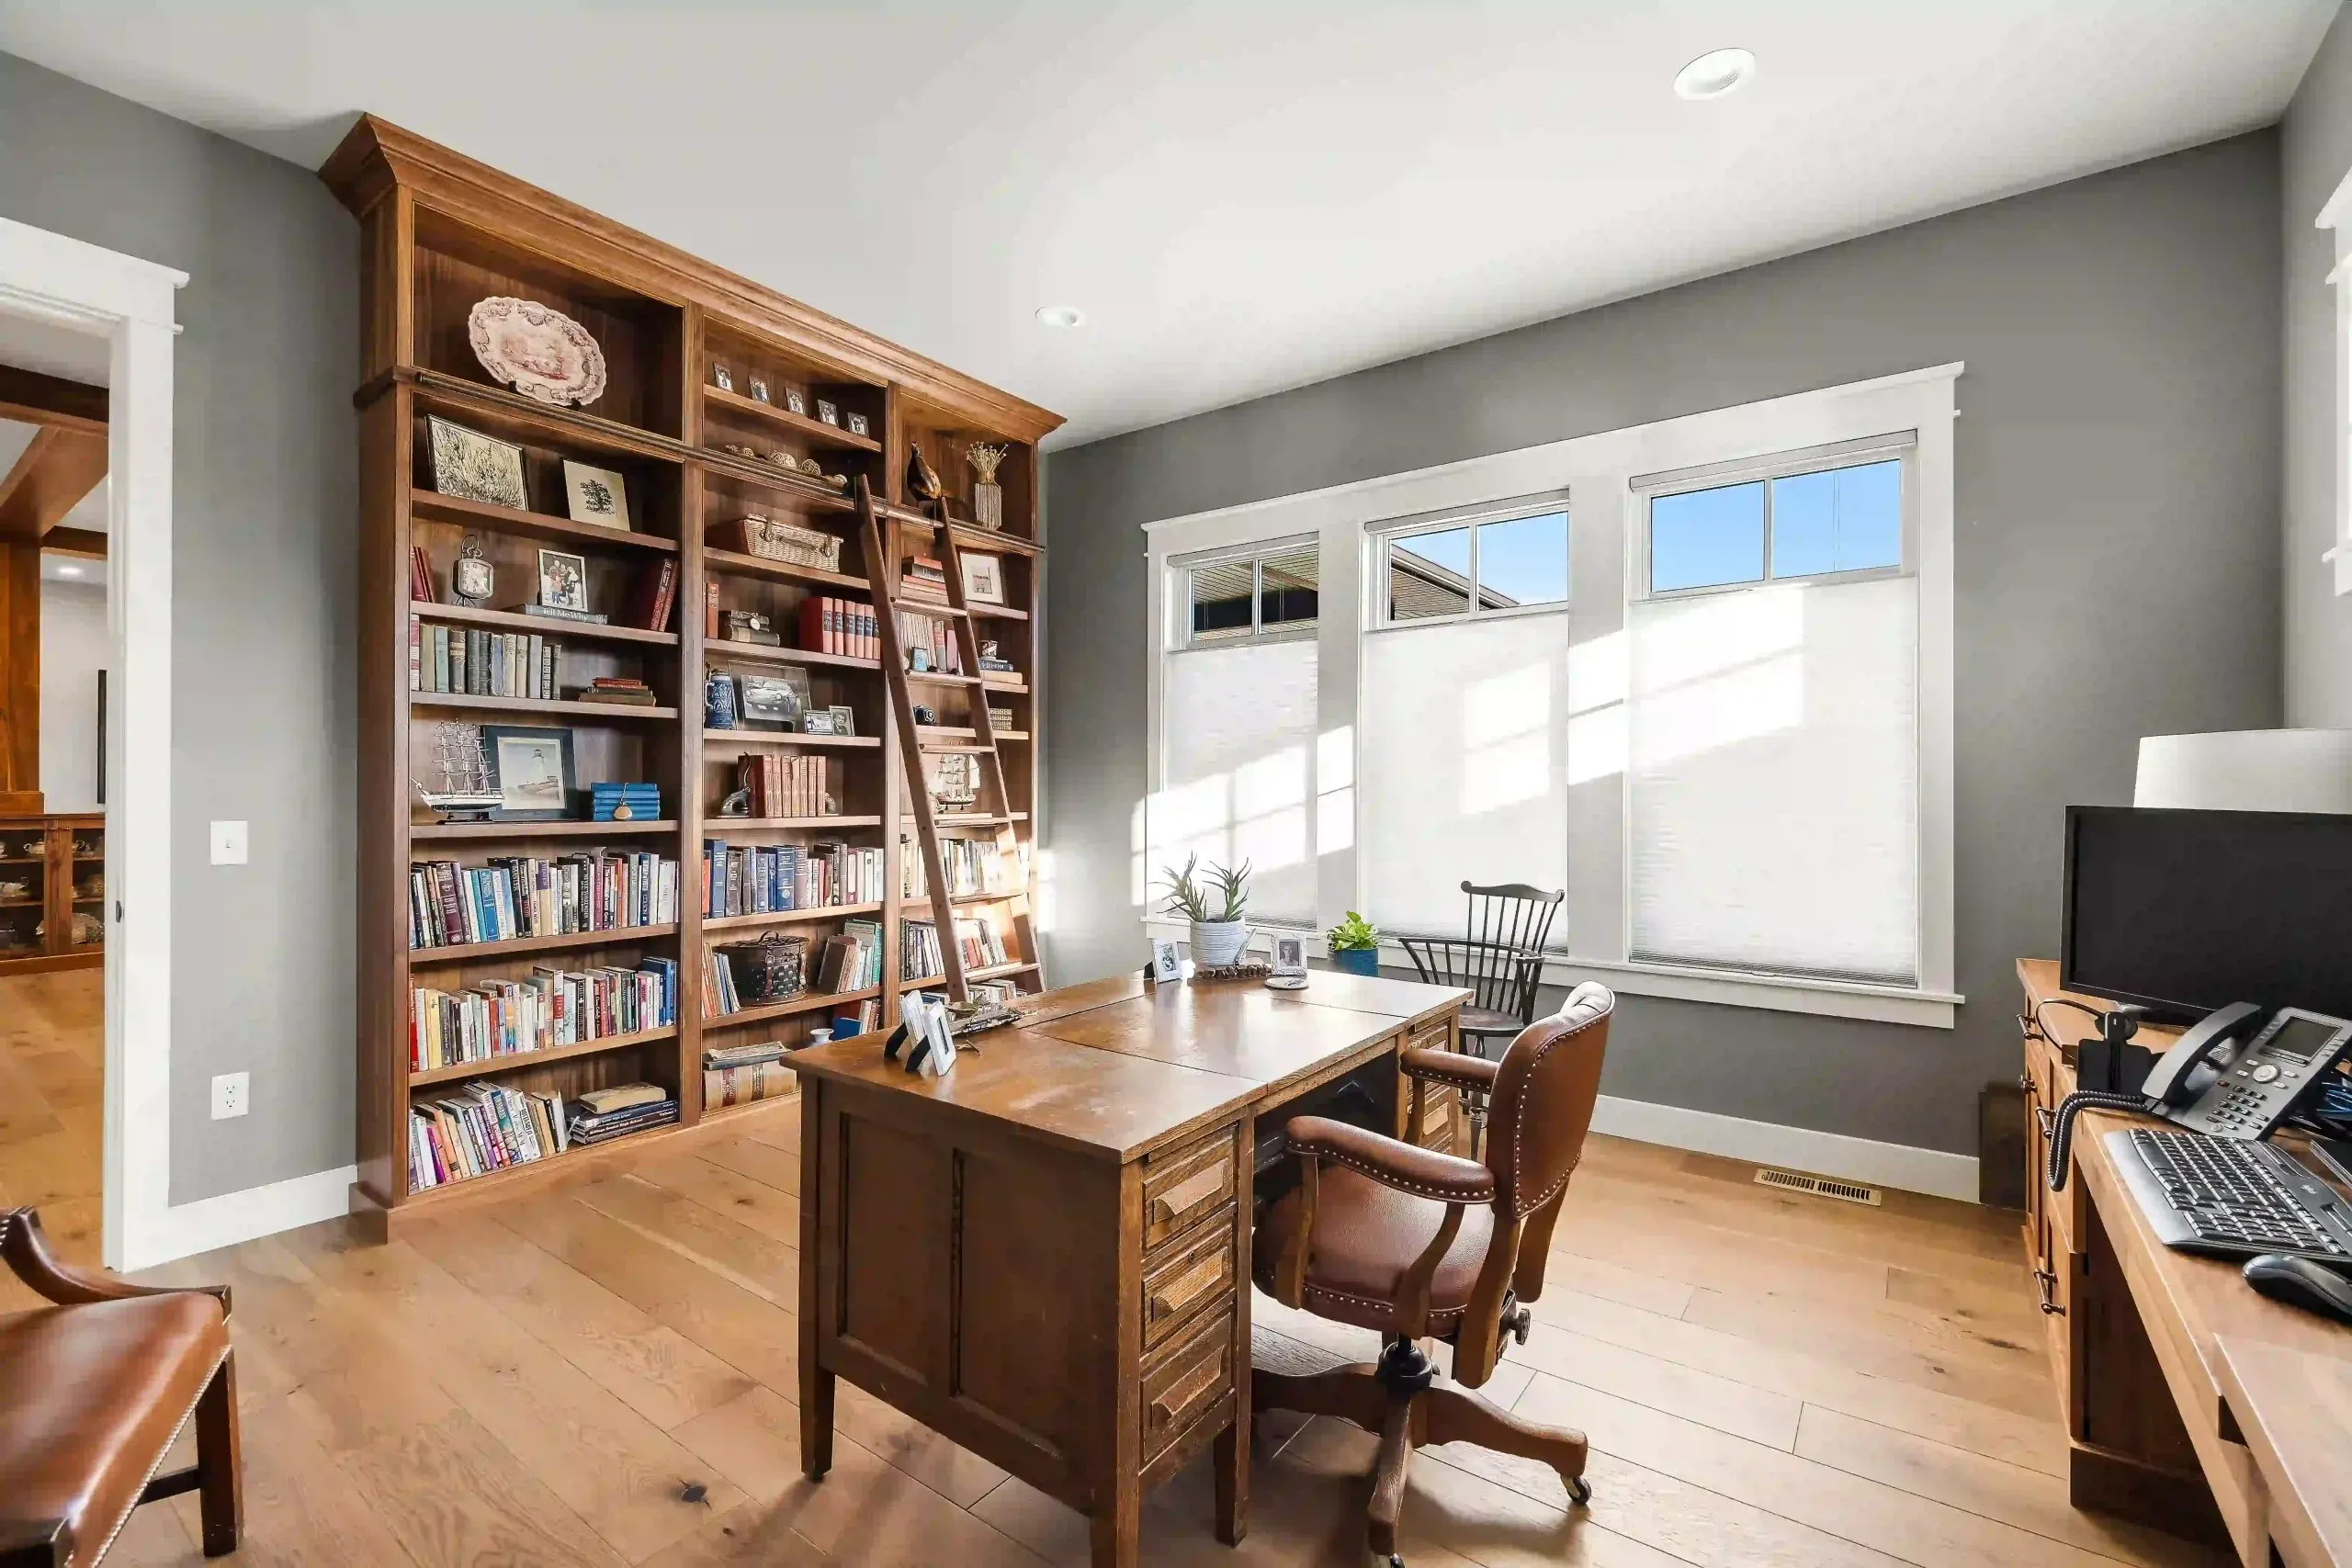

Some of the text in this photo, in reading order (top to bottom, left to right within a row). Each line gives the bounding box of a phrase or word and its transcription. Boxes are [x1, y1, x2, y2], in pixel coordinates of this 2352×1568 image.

[543, 608, 556, 616] Tell
[557, 610, 570, 618] Me
[570, 612, 589, 623] Why
